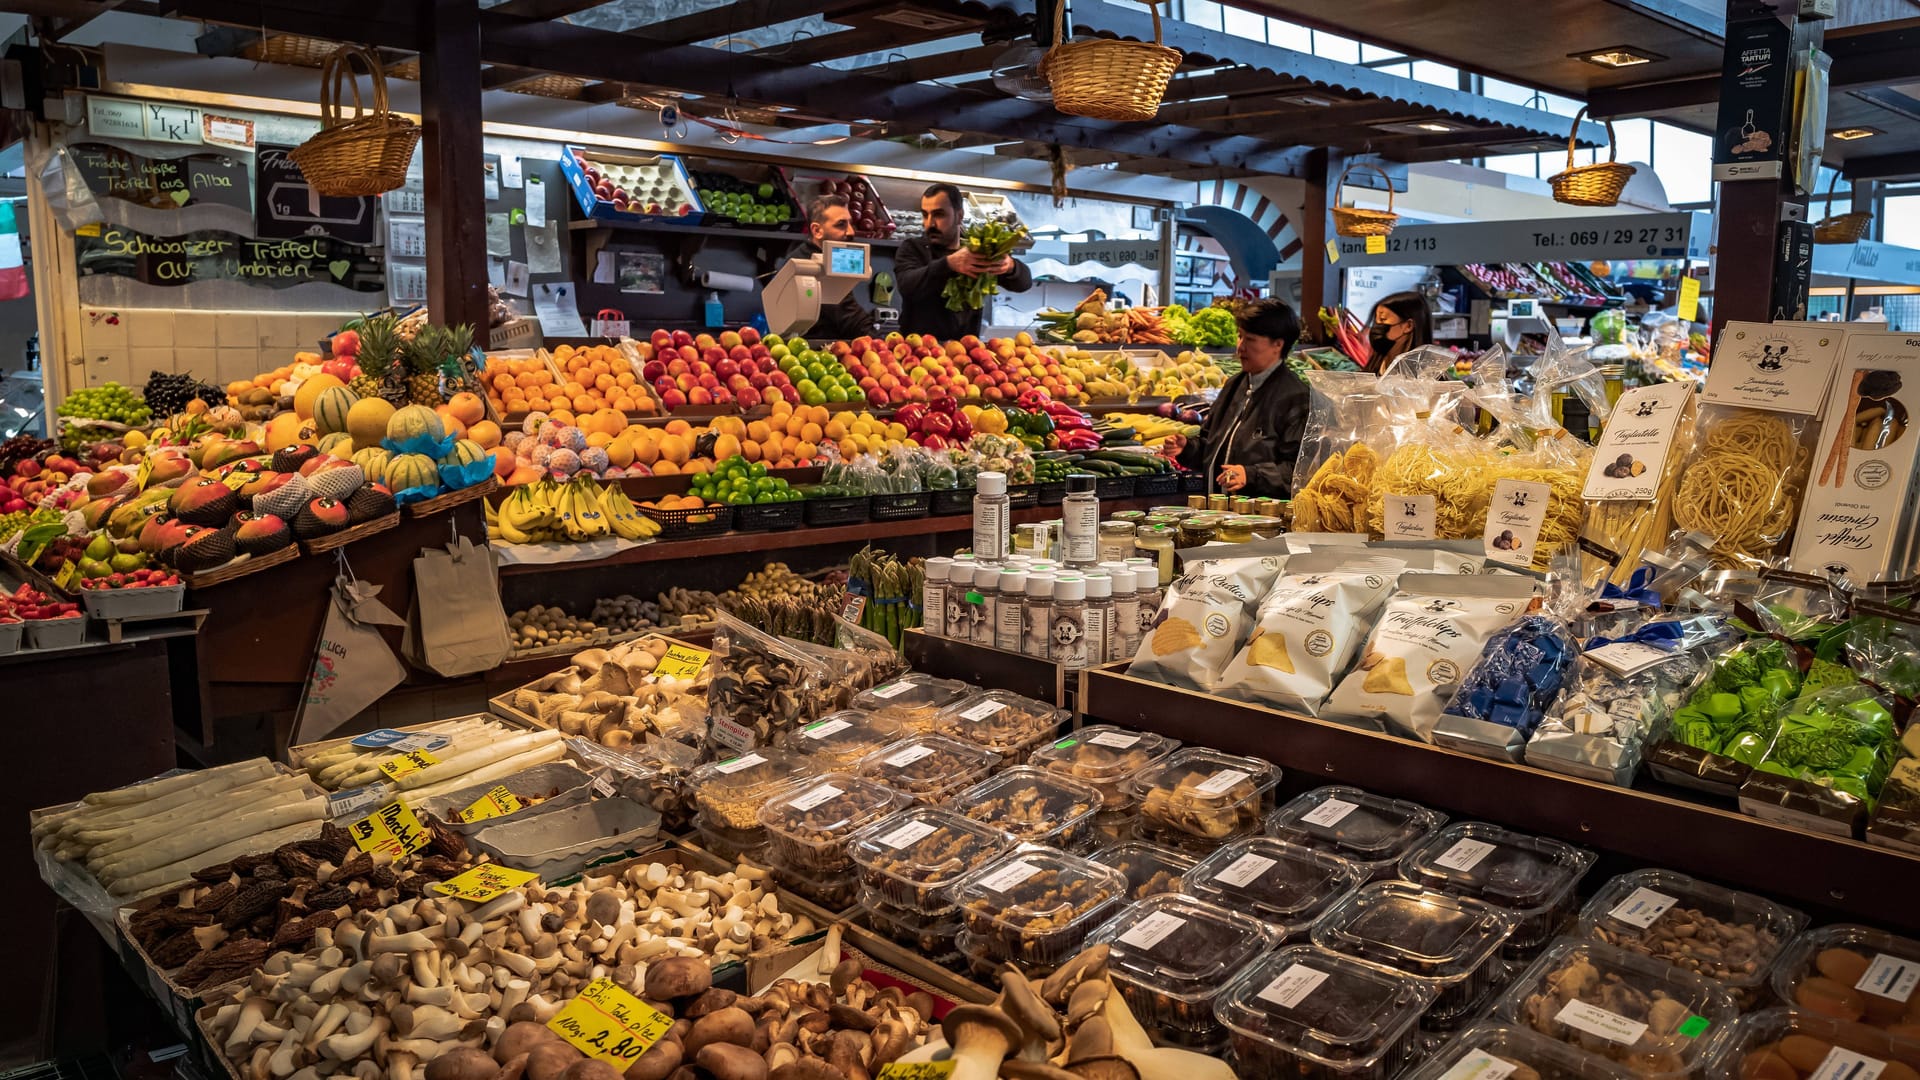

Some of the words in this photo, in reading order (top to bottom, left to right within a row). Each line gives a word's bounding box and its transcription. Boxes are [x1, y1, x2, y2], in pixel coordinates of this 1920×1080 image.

[1740, 54, 1771, 62] TARTUFI
[160, 179, 185, 190] aus
[193, 172, 233, 189] Alba
[276, 202, 291, 215] 1g
[104, 230, 232, 256] Schwarzer
[245, 240, 328, 260] Trüffel
[1413, 237, 1437, 251] 113
[1532, 232, 1566, 247] Tel.:
[1570, 230, 1599, 246] 069
[1603, 230, 1610, 245] /
[1613, 229, 1634, 245] 29
[1639, 228, 1659, 243] 27
[1664, 227, 1684, 242] 31
[225, 258, 314, 279] Umbrien
[1816, 513, 1879, 531] Grissini
[1816, 527, 1873, 549] Trüffel-
[1208, 574, 1247, 600] Rustico
[1387, 610, 1462, 638] Trüffelchips
[718, 718, 750, 740] Steinpilze
[582, 987, 610, 1005] Shii
[610, 1003, 629, 1024] Take
[586, 1029, 643, 1060] 2,80
